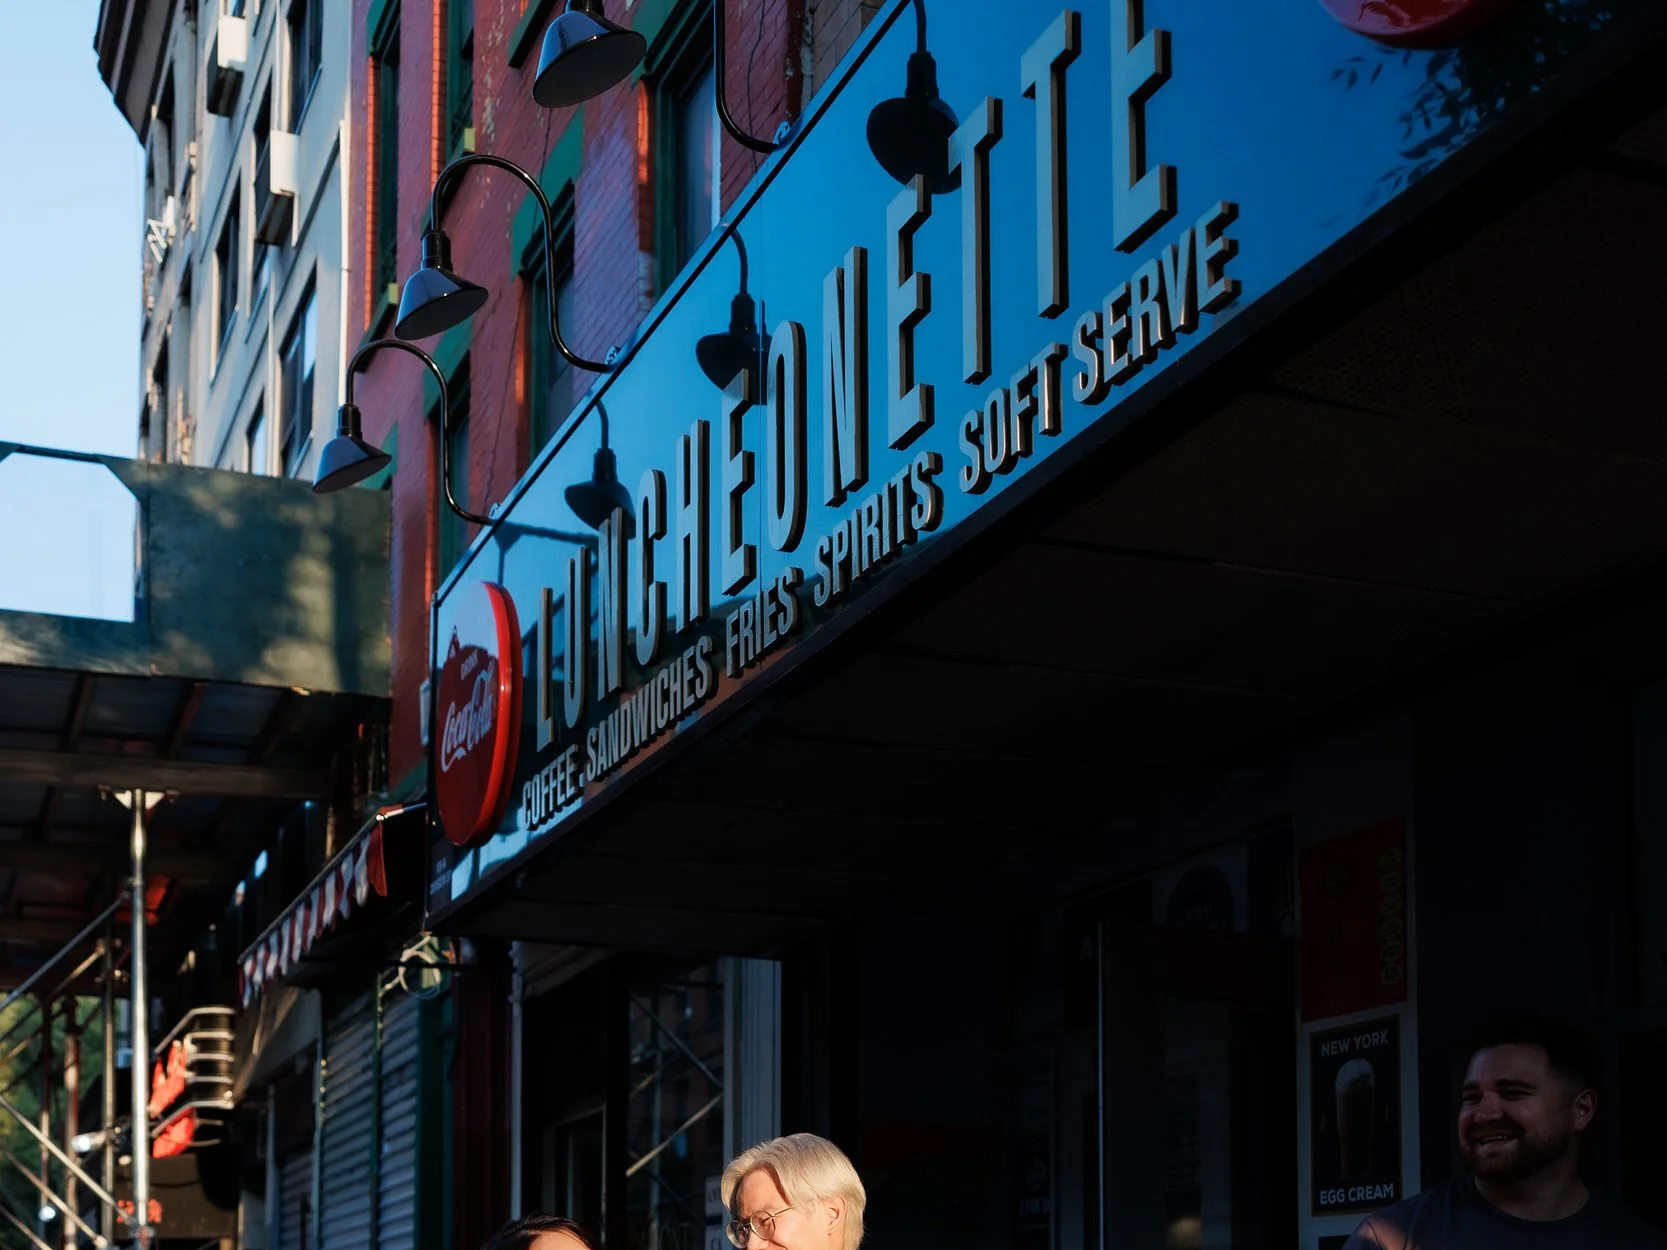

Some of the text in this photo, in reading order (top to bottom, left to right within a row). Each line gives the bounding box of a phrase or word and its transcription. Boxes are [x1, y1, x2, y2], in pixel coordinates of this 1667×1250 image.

[523, 201, 1238, 829] COFFEE SANDWICHES FRIES SPIRITS SOFT SERVE
[537, 0, 1176, 752] LUNCHEONETTE
[1320, 1182, 1394, 1204] EGG CREAM
[1321, 1029, 1389, 1057] NEW YORK
